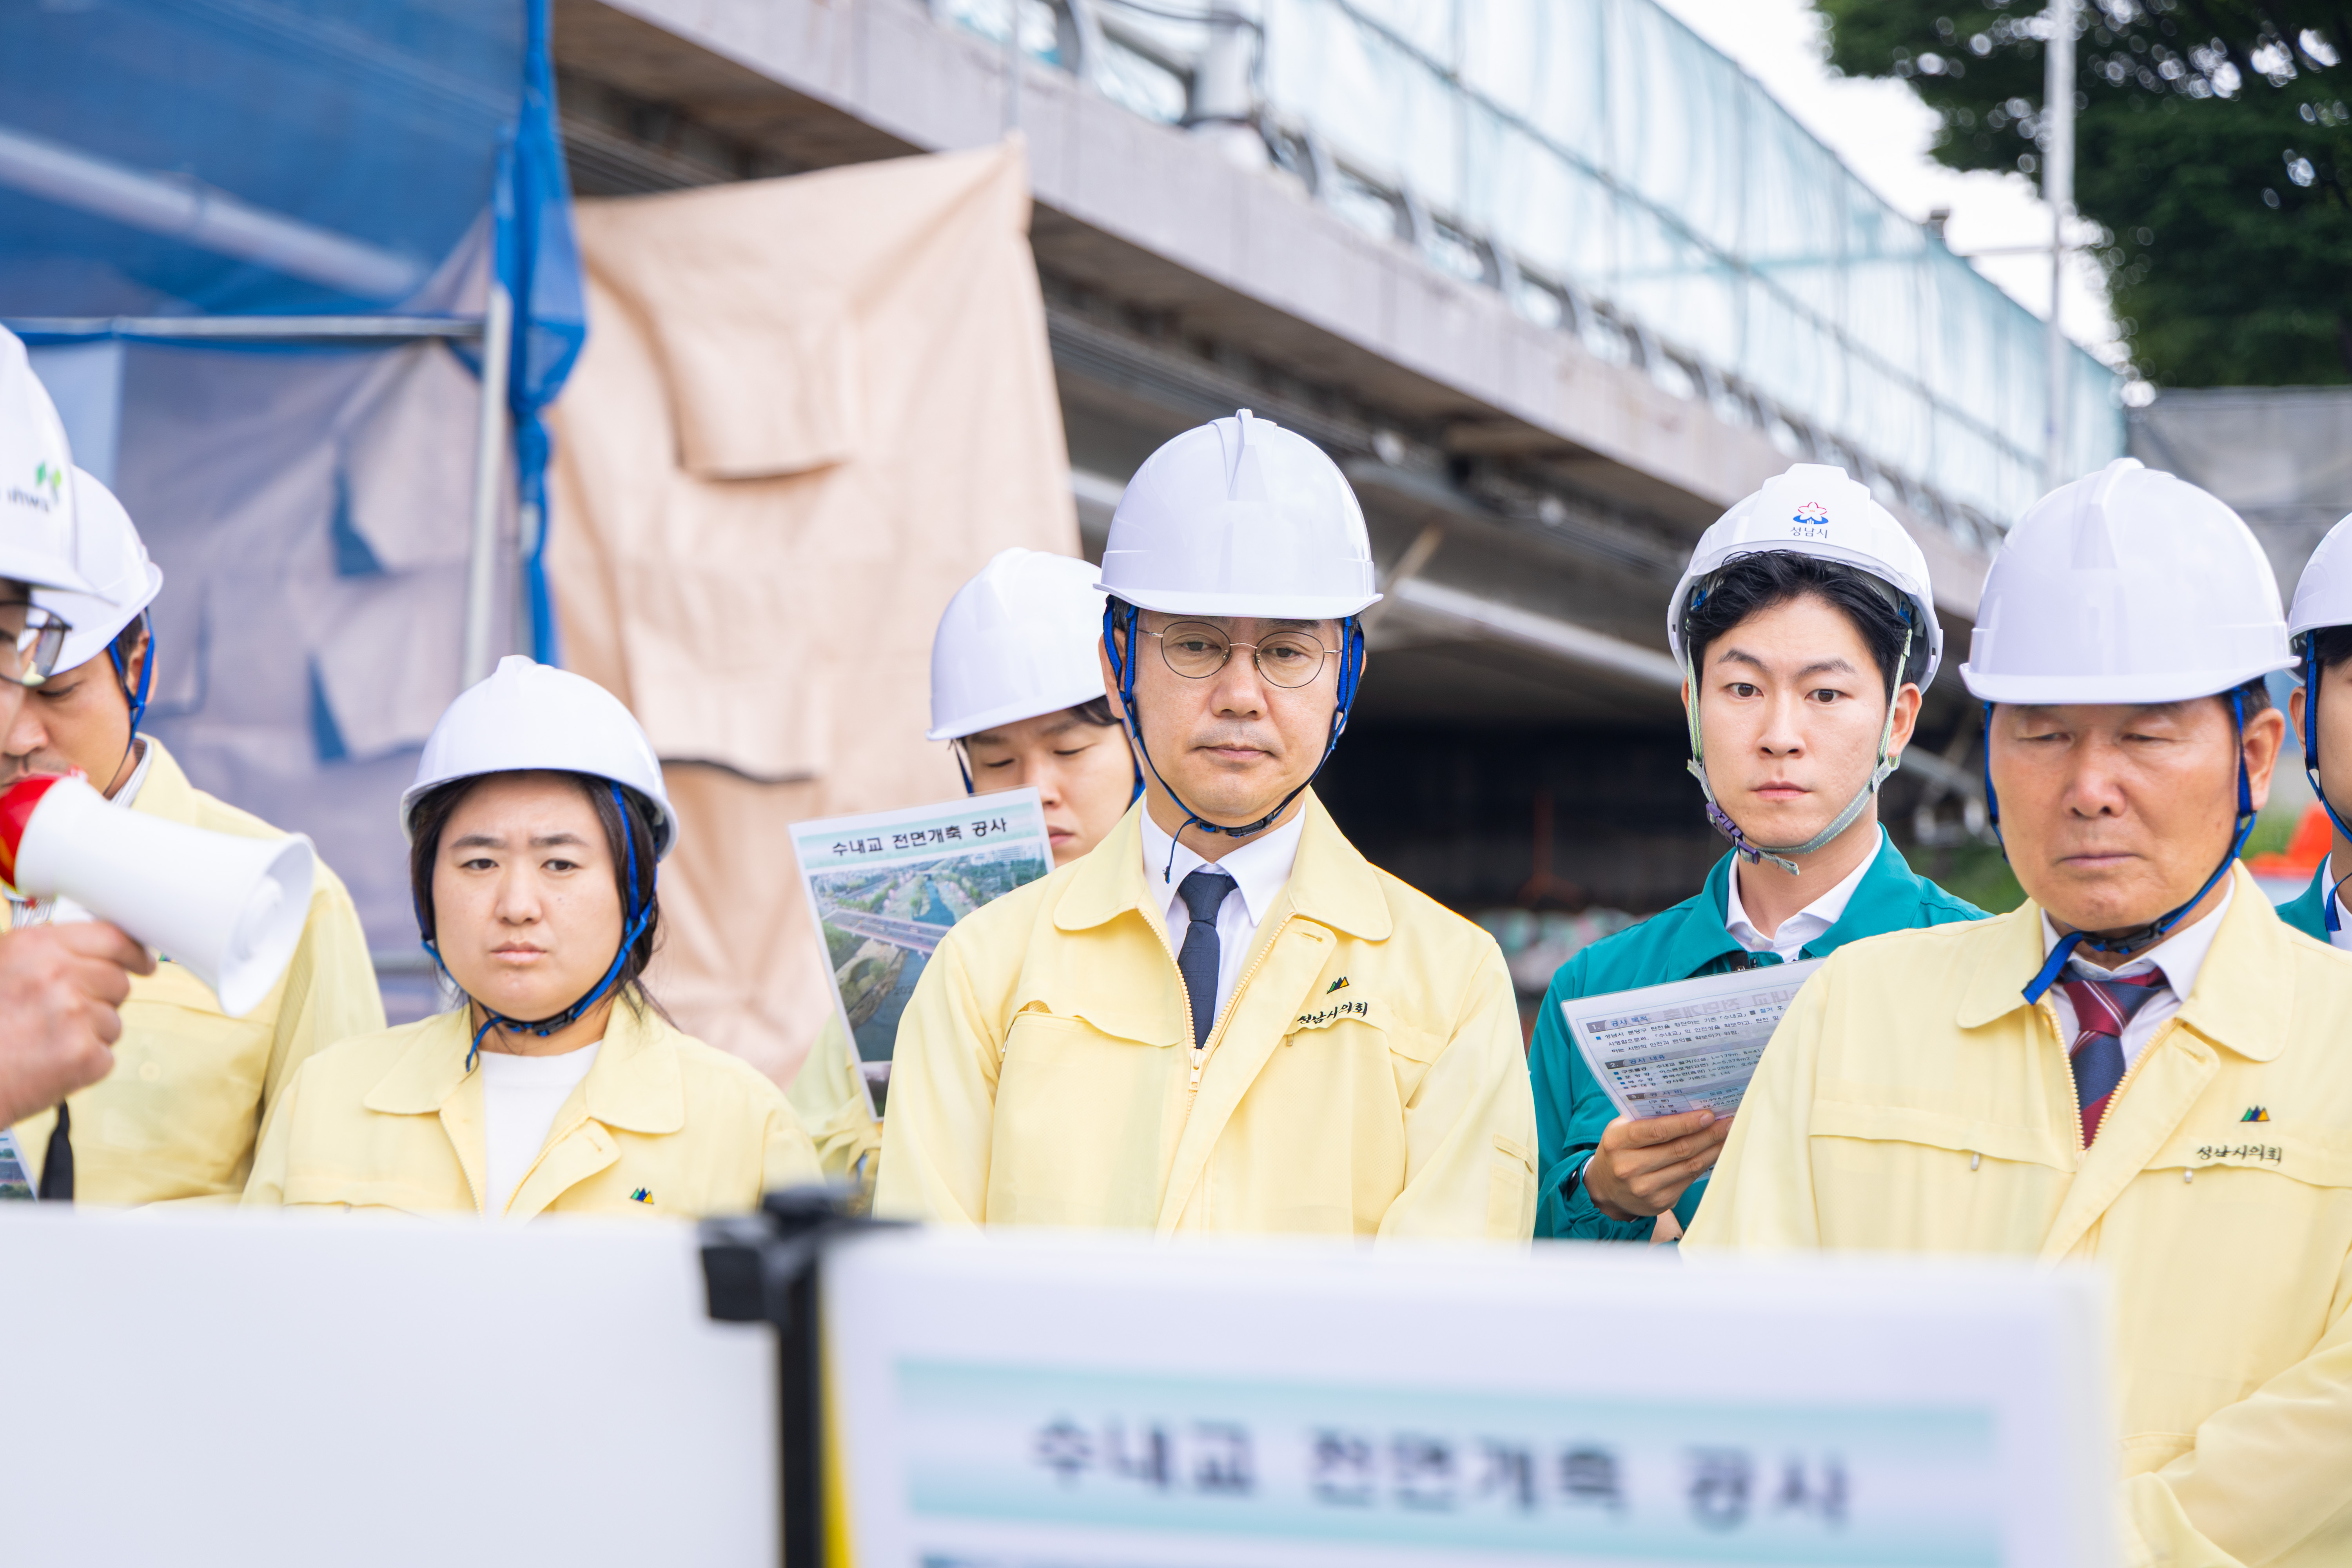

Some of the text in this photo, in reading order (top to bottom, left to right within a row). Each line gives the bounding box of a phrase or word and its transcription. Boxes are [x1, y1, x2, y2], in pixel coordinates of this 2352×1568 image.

[1790, 527, 1828, 539] 성남시
[833, 818, 1007, 857] 수내교 전면개축 공사
[1297, 1002, 1368, 1024] 성남시의회
[2197, 1144, 2282, 1166] 성남시의회
[1034, 1413, 1258, 1498] 수내교
[1685, 1445, 1849, 1535] 공사
